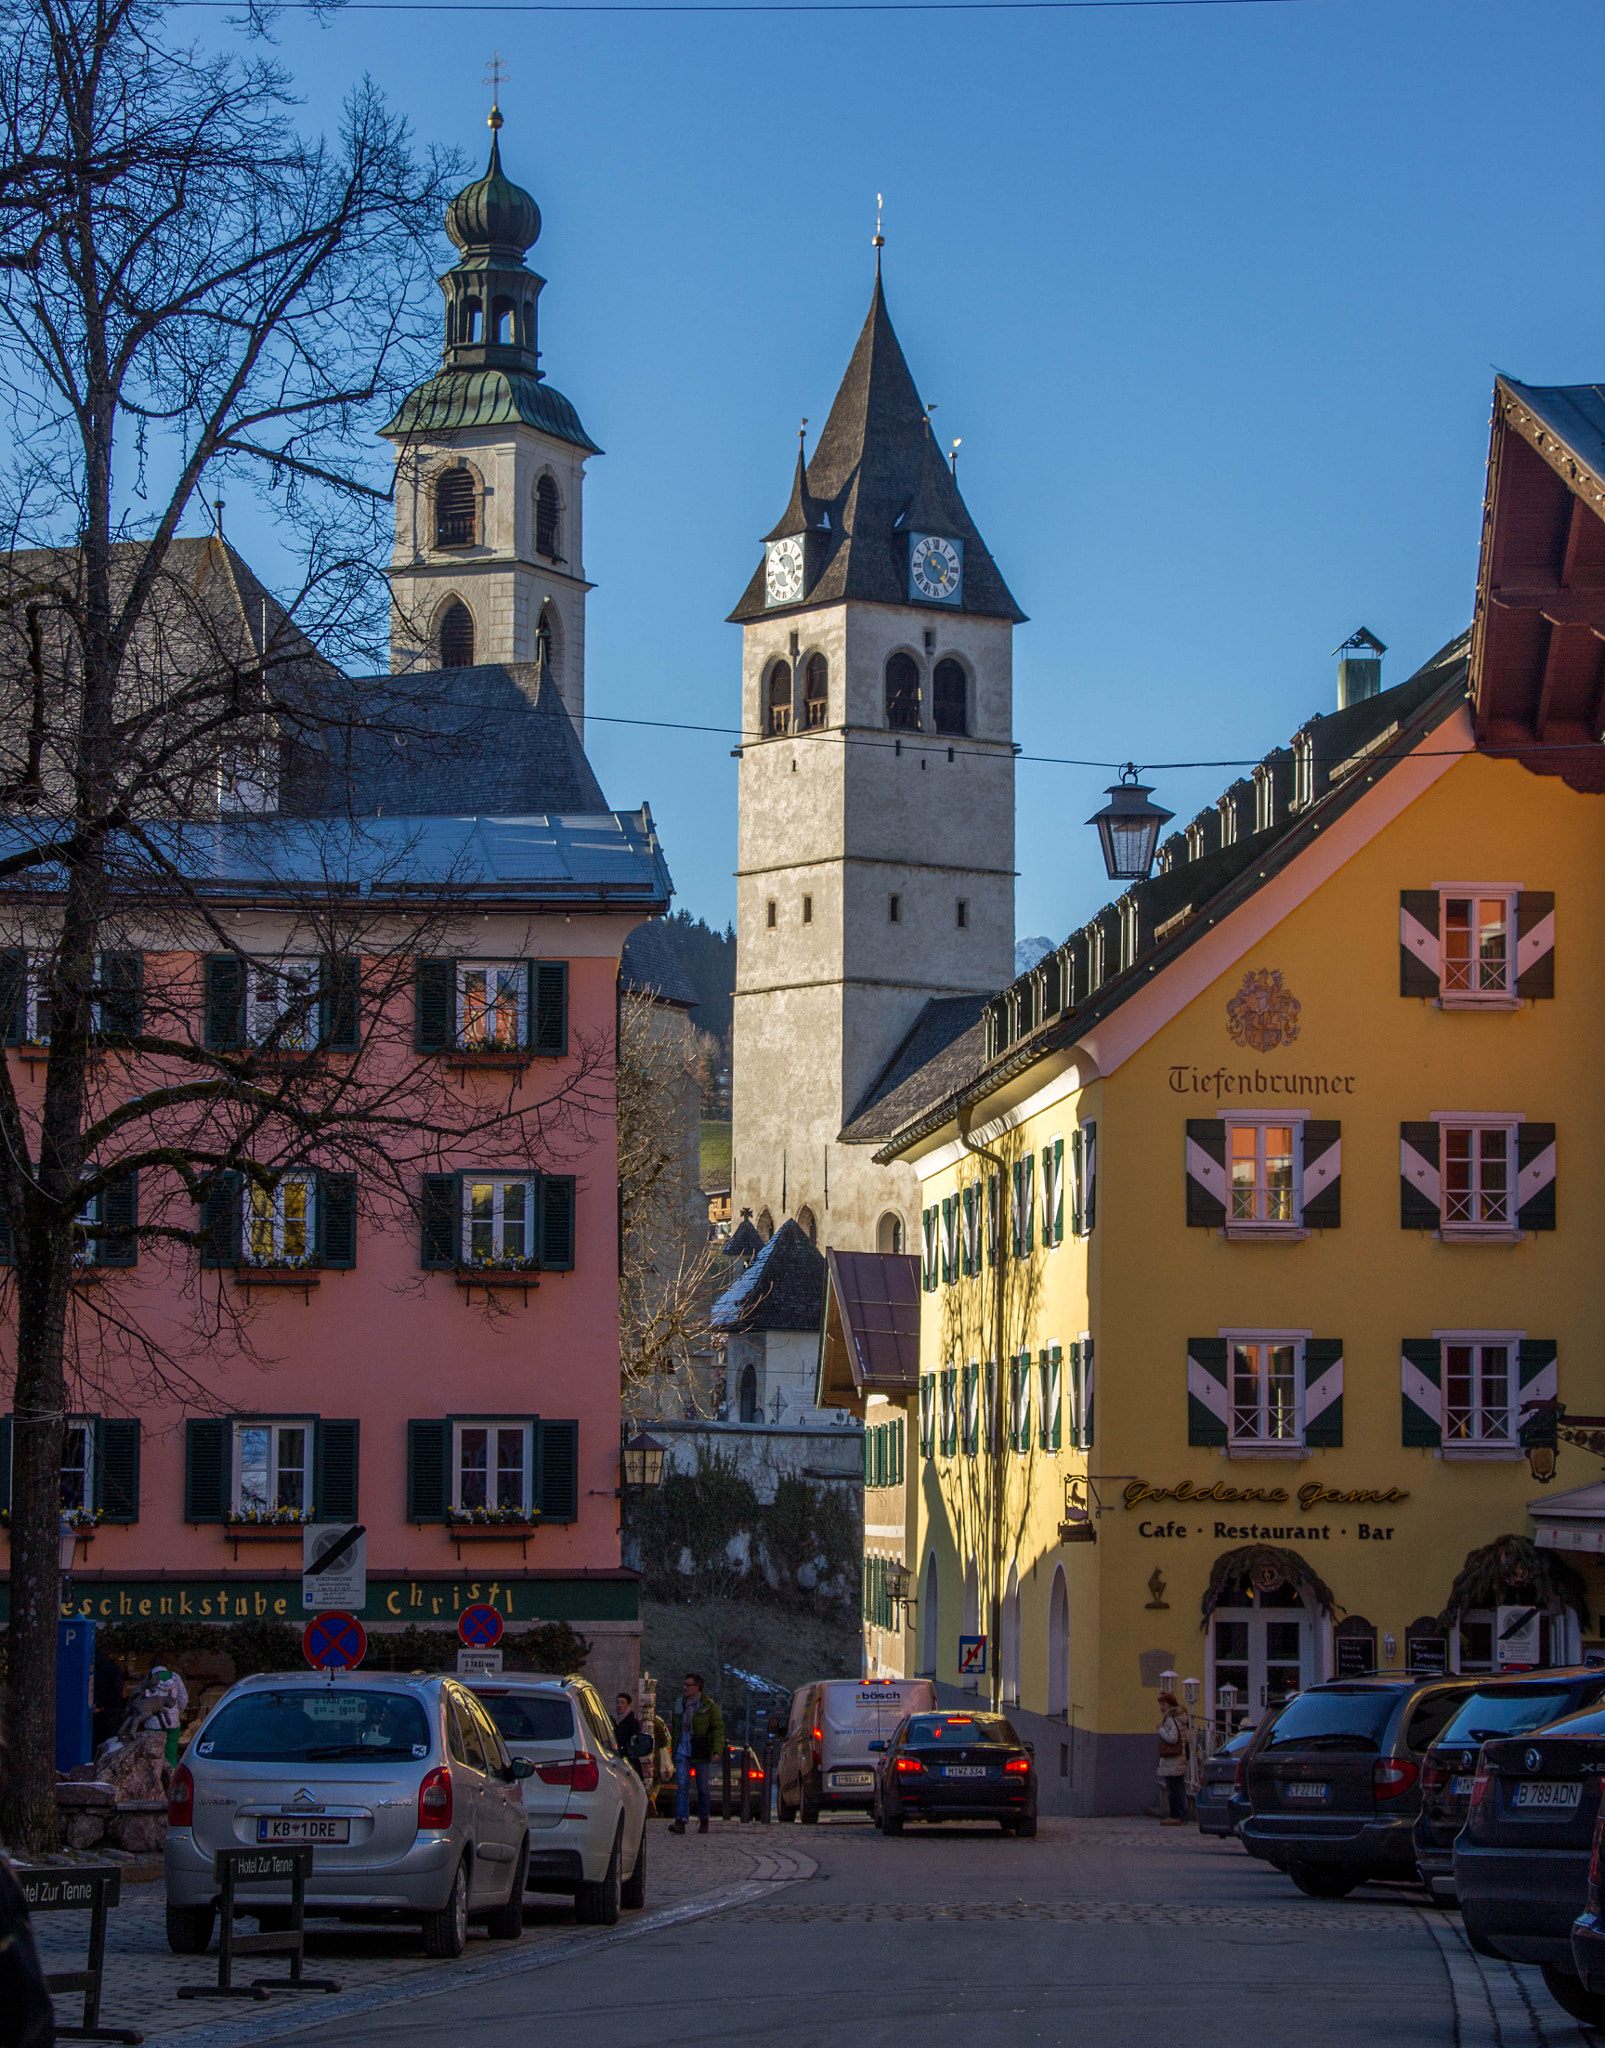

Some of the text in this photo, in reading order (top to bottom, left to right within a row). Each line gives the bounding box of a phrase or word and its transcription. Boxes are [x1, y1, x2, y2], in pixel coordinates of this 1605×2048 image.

[1168, 1065, 1356, 1100] Tiefenbrunner
[1123, 1480, 1410, 1511] Goldene Gams
[1138, 1521, 1394, 1540] Cafe Restaurant Bar
[61, 1581, 513, 1616] eschenkstube Christl
[66, 1629, 76, 1646] P
[862, 1691, 901, 1700] bösch
[1518, 1784, 1579, 1804] B 789 ADN
[273, 1822, 291, 1837] KB
[301, 1822, 337, 1837] 1DRE
[238, 1855, 294, 1874] Hotel Zur Tenne
[23, 1880, 92, 1903] tel Zur Tenne
